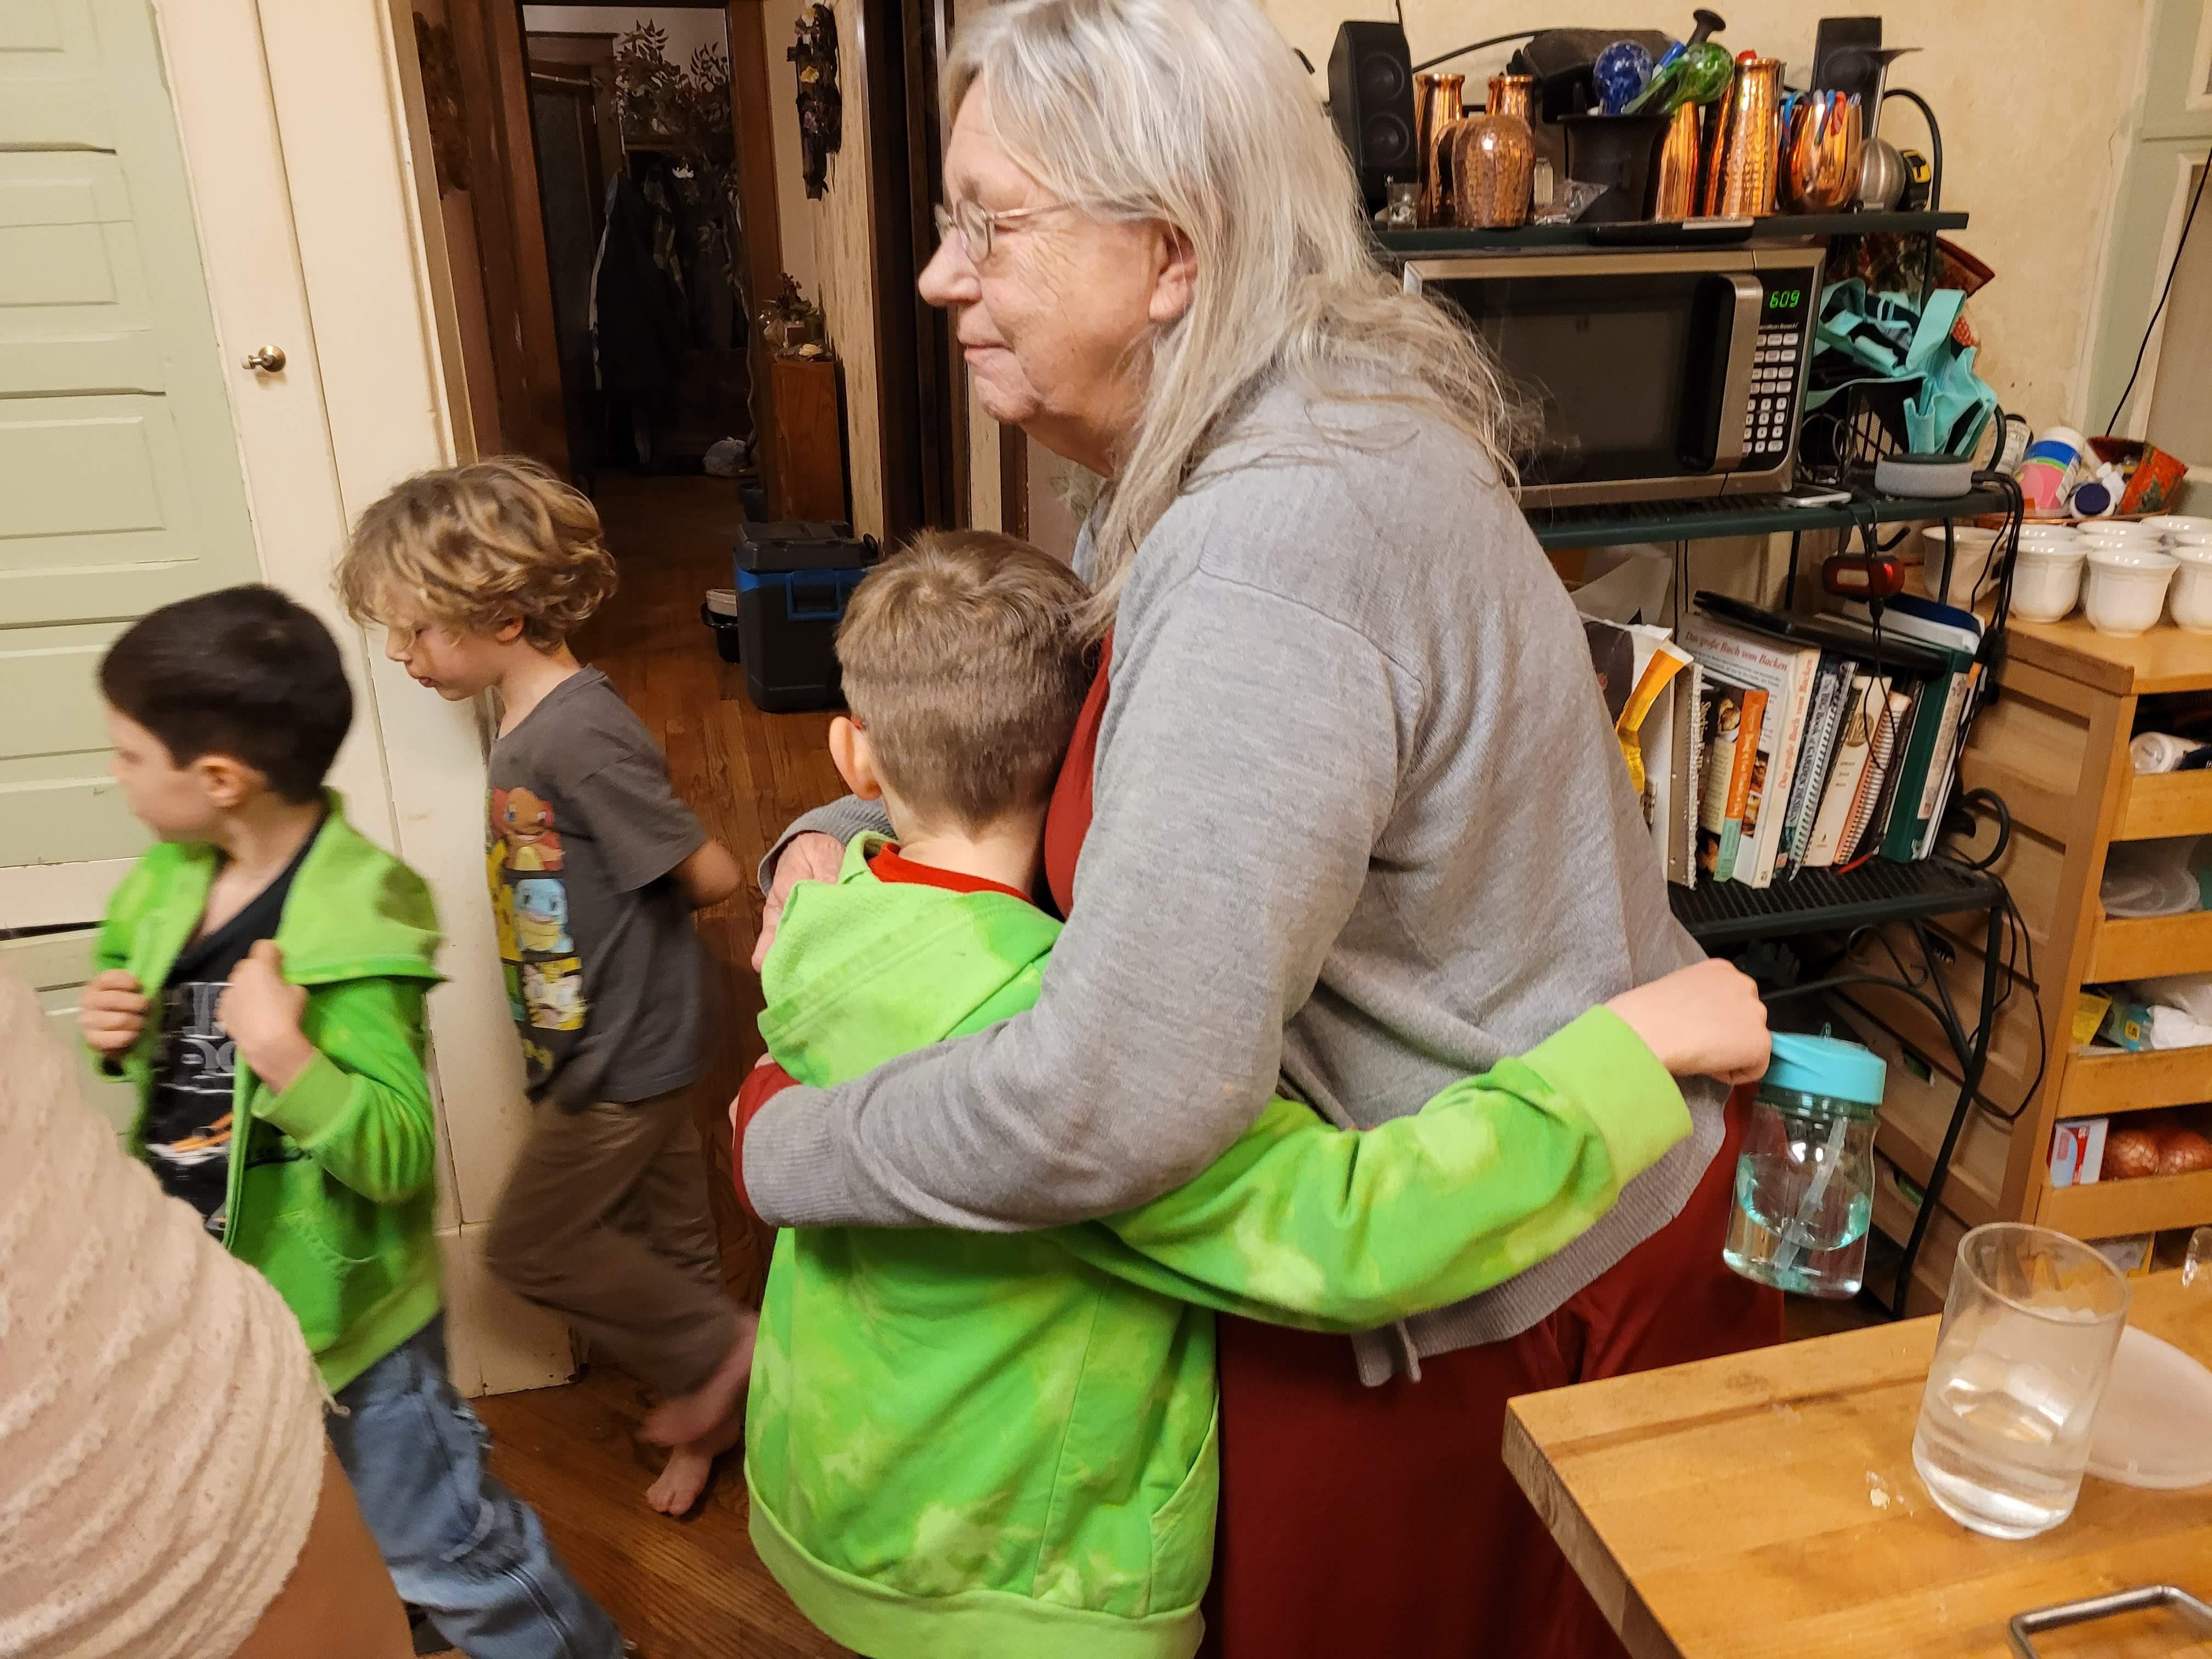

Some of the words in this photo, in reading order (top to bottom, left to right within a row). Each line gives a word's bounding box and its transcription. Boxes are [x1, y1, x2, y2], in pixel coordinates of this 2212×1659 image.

[1685, 631, 1699, 642] Das
[1720, 641, 1740, 657] Buch
[1742, 650, 1758, 661] vom
[1759, 654, 1788, 672] Backen
